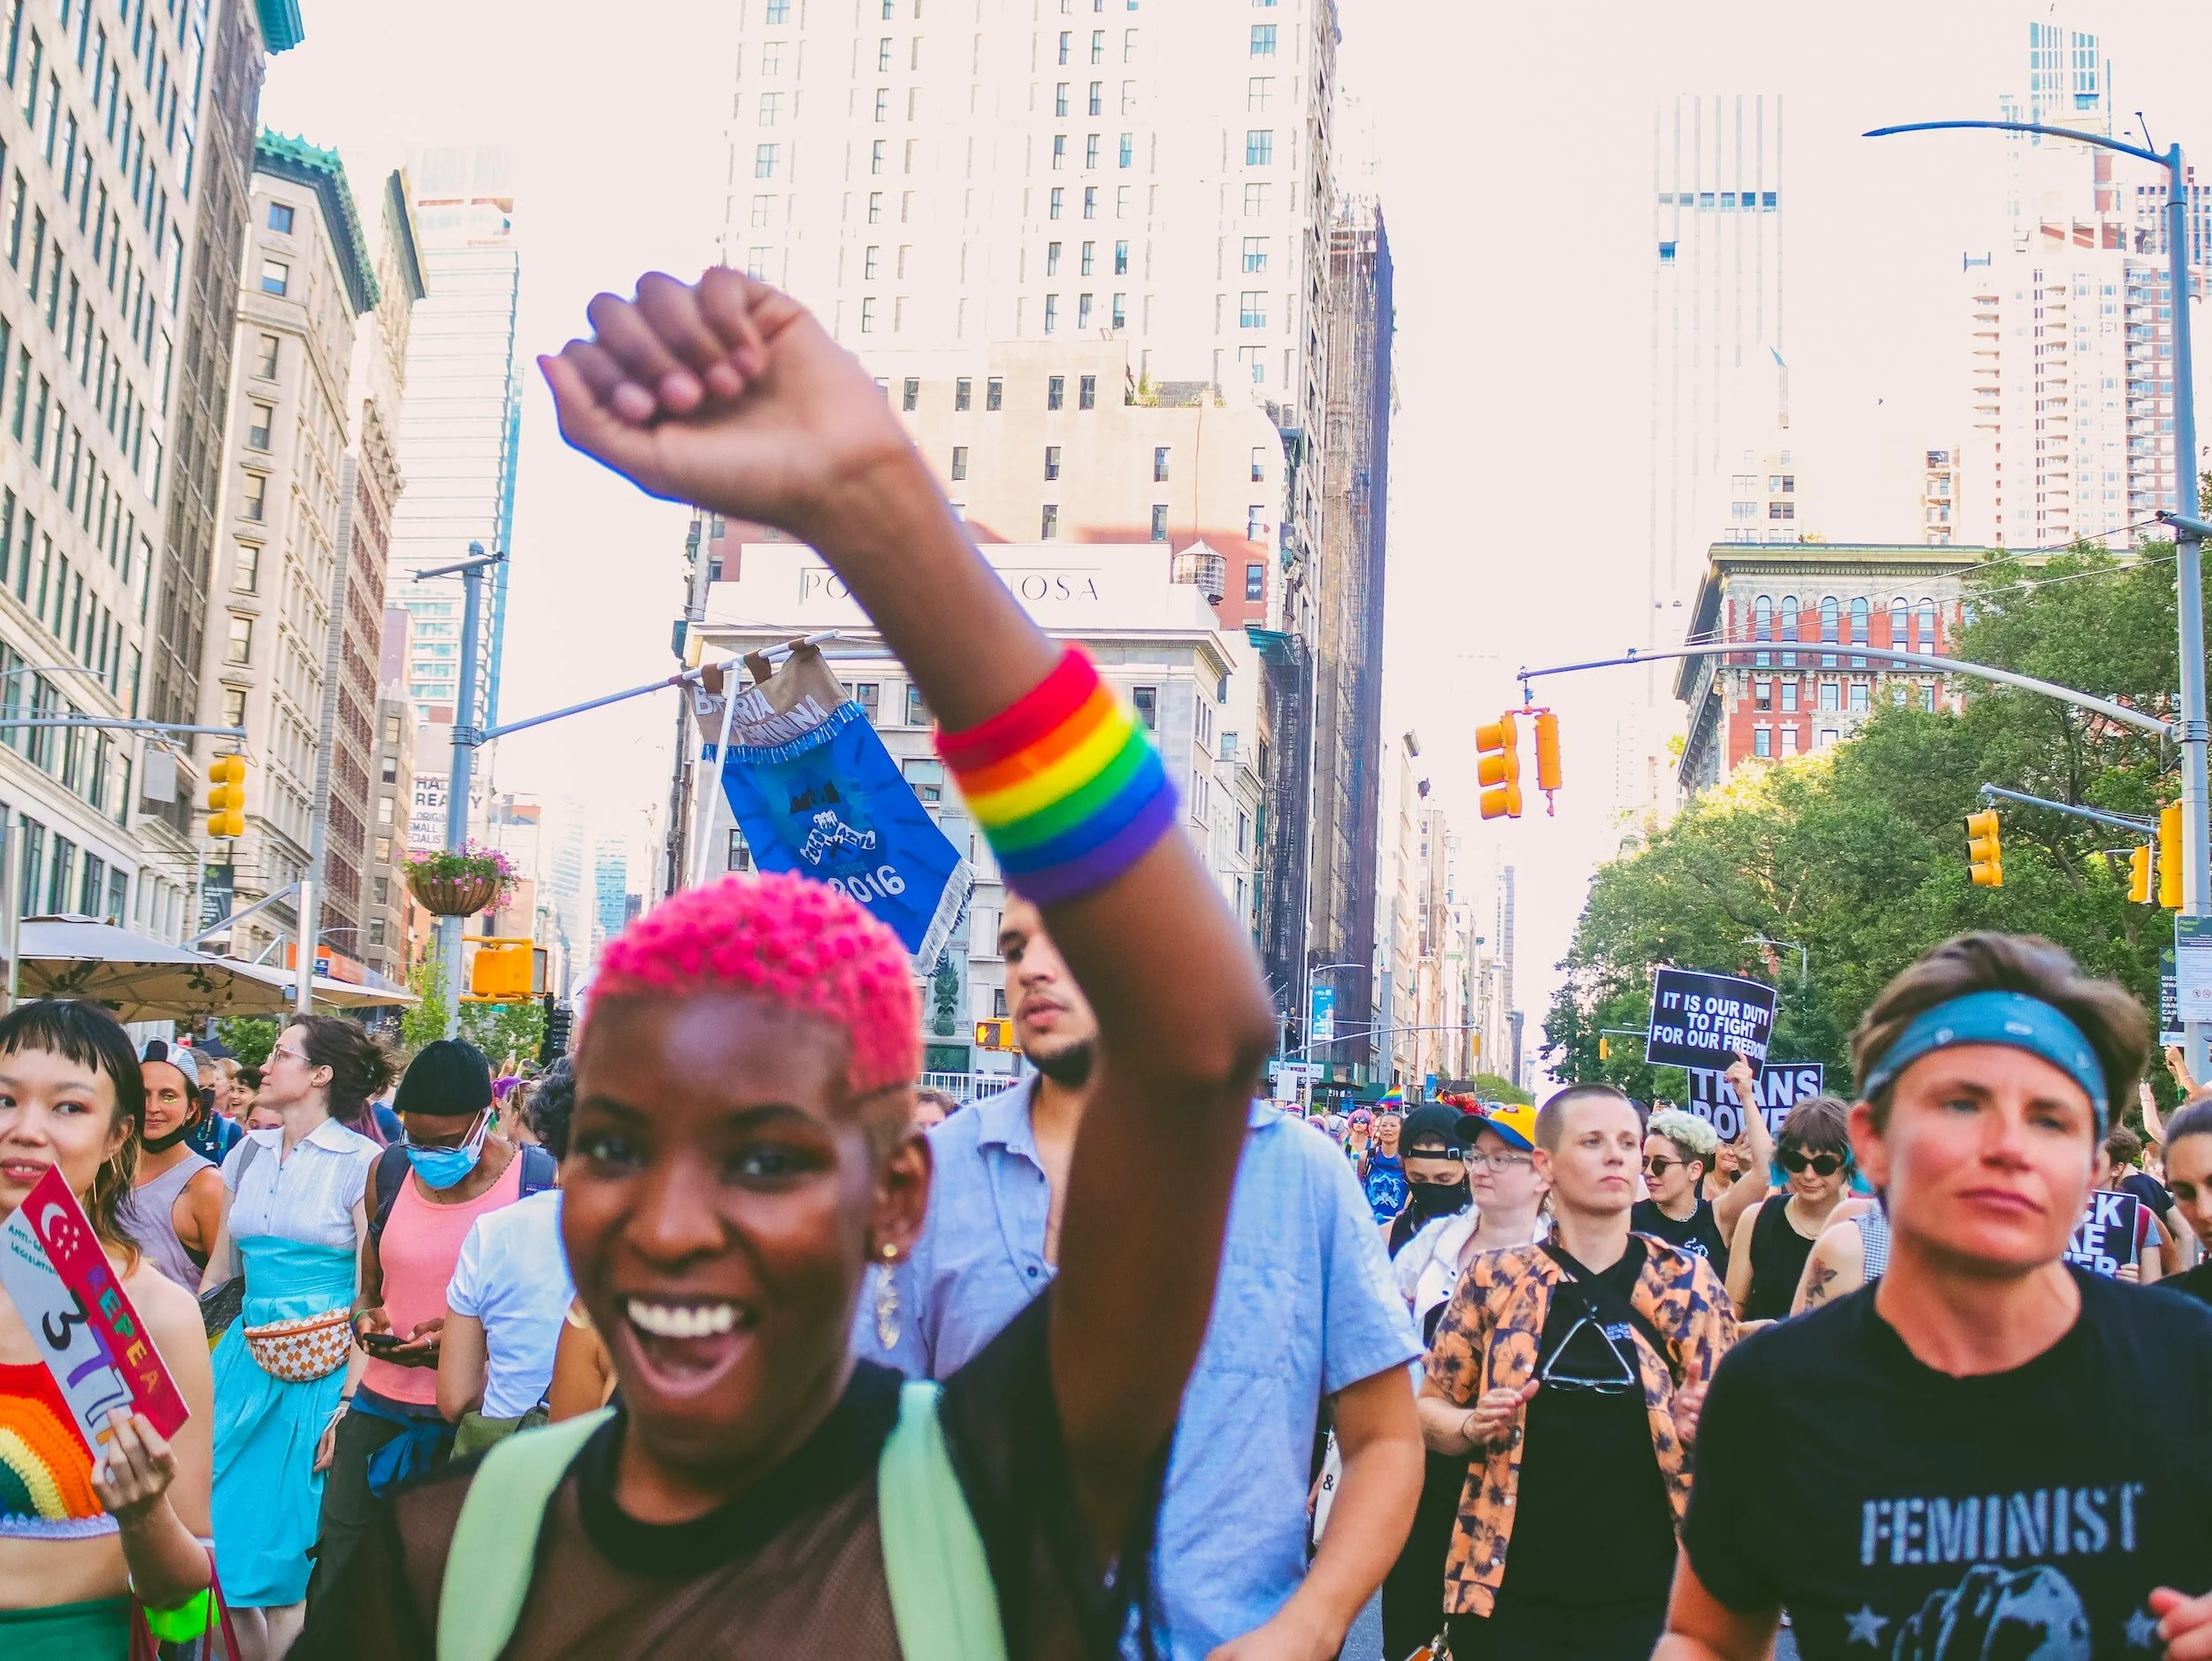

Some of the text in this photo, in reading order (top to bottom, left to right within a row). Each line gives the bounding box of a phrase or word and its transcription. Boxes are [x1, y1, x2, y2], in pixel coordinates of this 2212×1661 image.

[1662, 991, 1770, 1027] IT IS OUR DUTY
[1686, 1011, 1756, 1039] TO FIGHT
[1653, 1025, 1683, 1045] FOR
[1686, 1031, 1719, 1050] OUR
[42, 1286, 135, 1446] 377
[1861, 1480, 2145, 1566] FEMINIST
